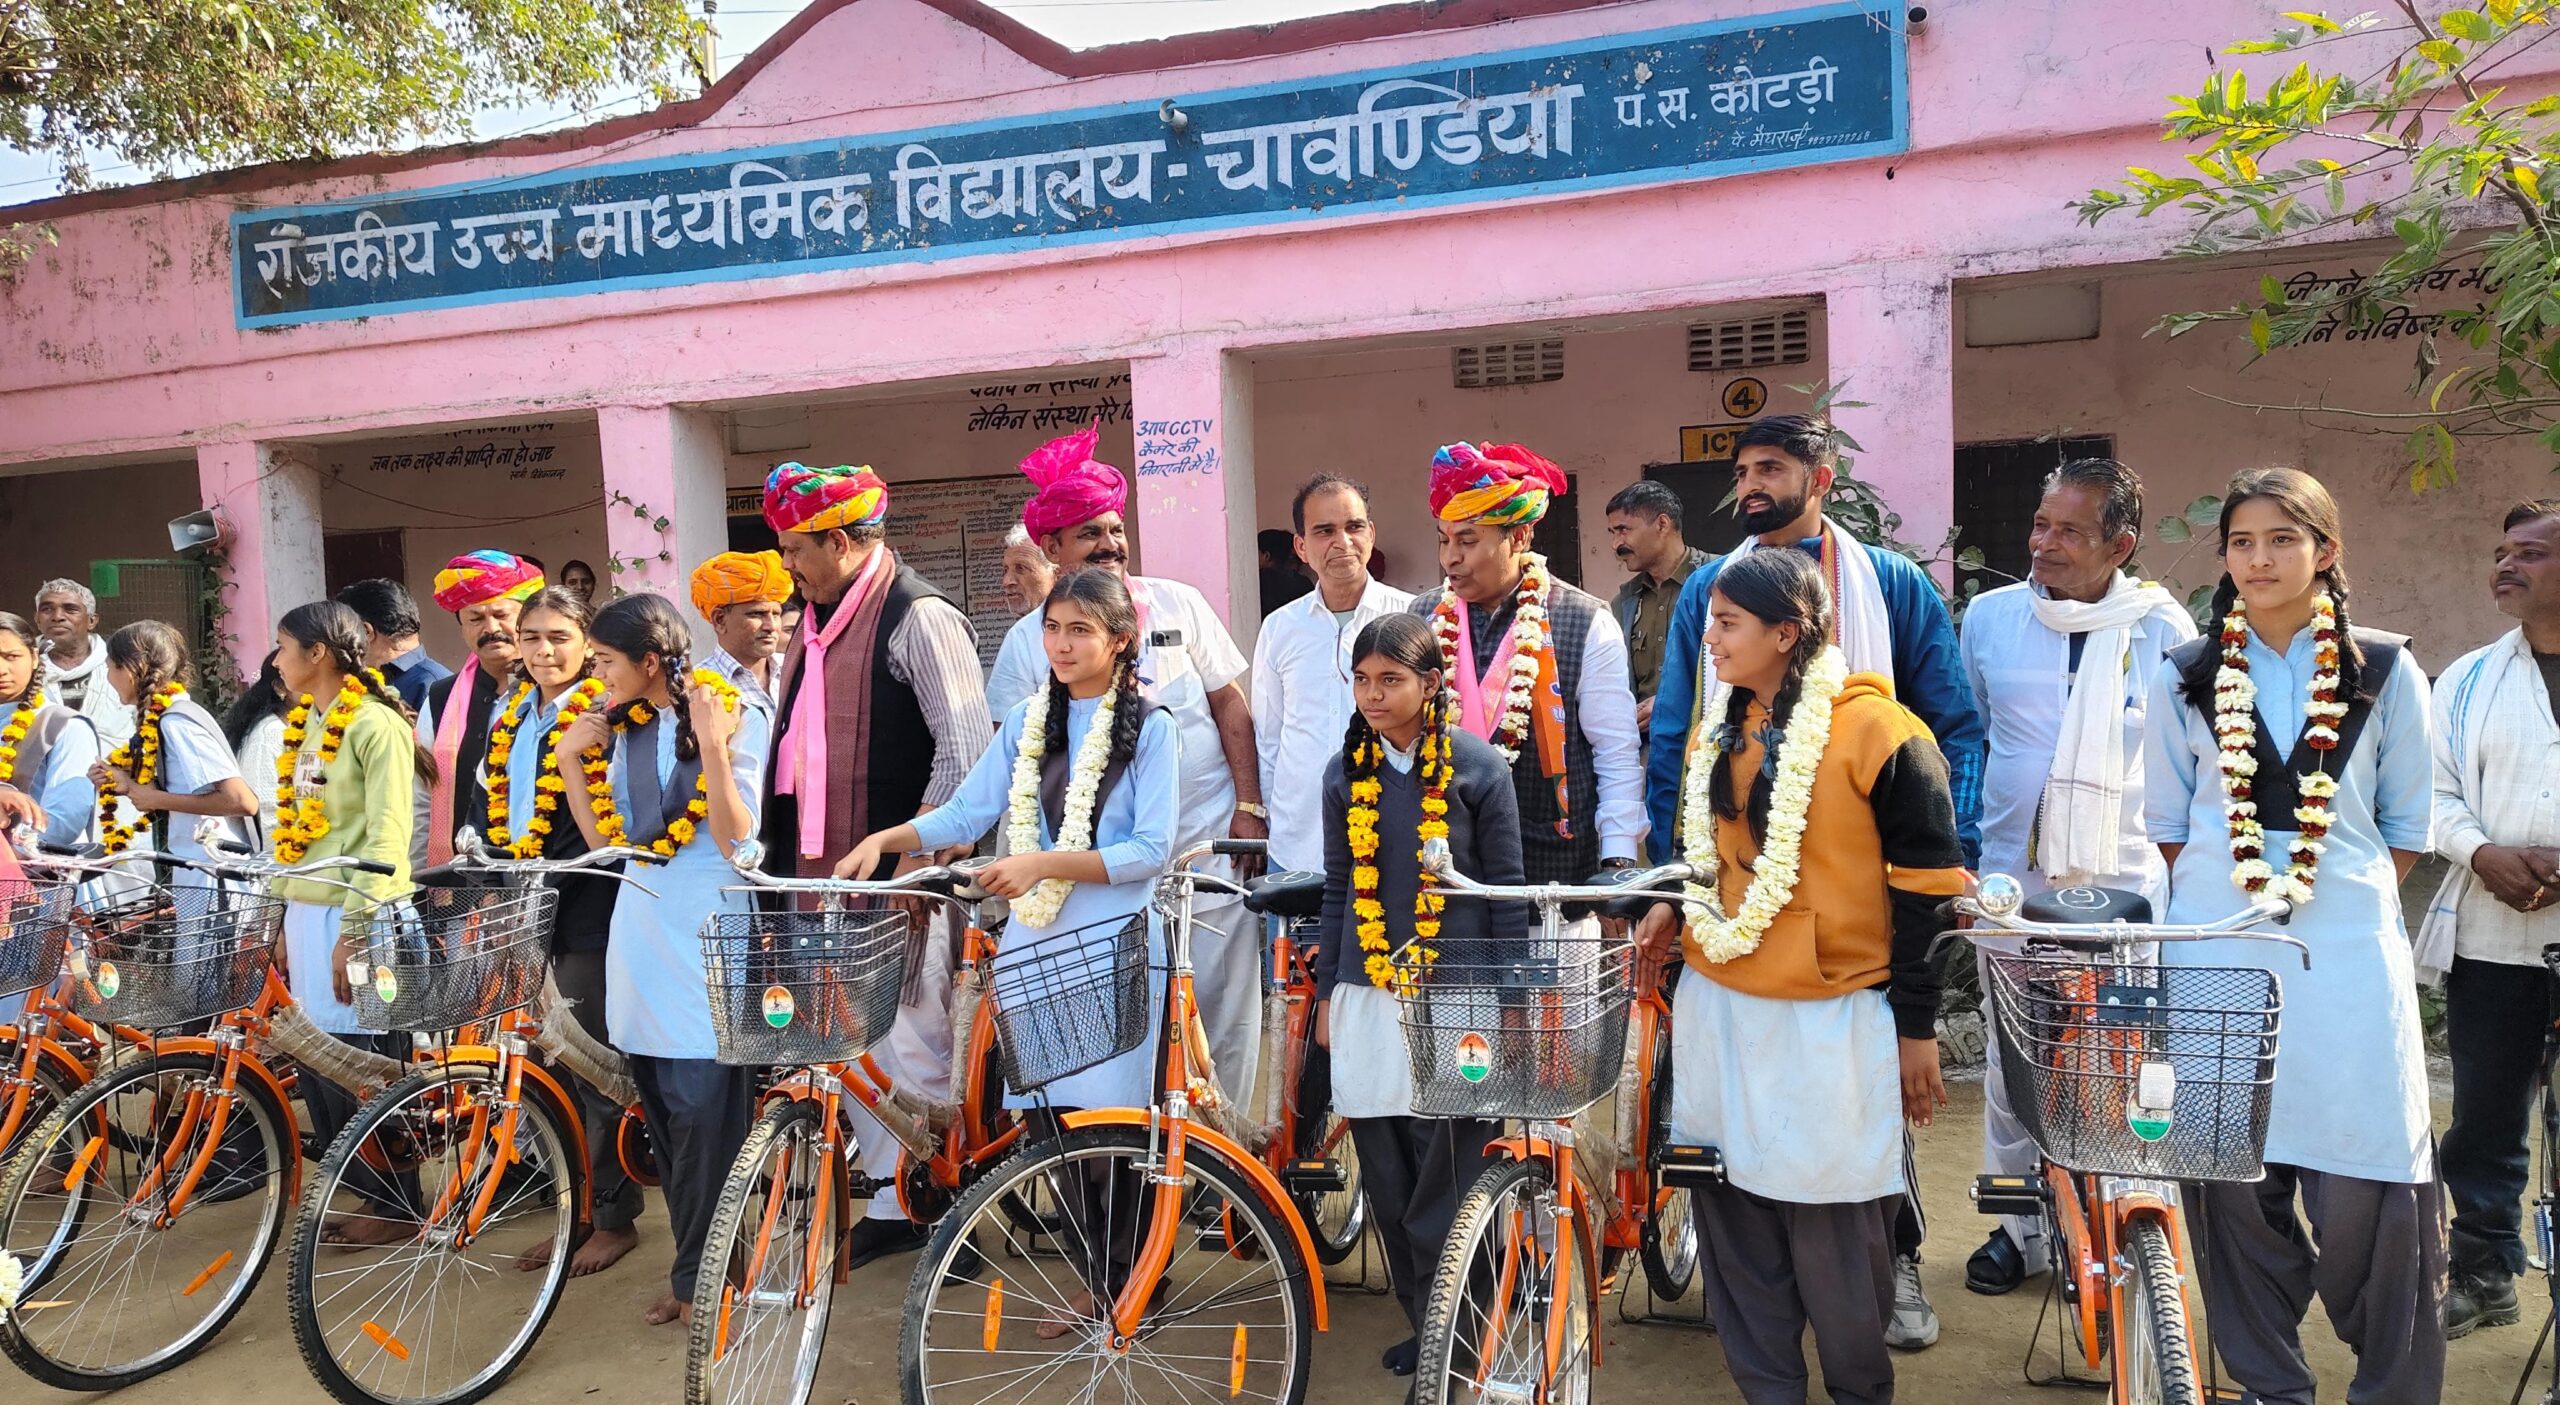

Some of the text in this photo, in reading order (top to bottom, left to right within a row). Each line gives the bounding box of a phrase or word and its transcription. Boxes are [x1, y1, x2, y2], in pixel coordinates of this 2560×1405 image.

[254, 210, 441, 299] राजकीय
[452, 208, 561, 270] उच्च
[572, 161, 872, 260] माध्यमिक
[890, 143, 1167, 230] विद्यालय
[1201, 78, 1585, 192] चावण्डिया
[1732, 386, 1755, 411] 4
[968, 403, 1031, 431] लेकिन
[1032, 402, 1091, 430] संस्था
[1136, 419, 1213, 436] आप CCTV
[369, 455, 393, 471] जब
[390, 454, 413, 472] तक
[445, 445, 464, 467] की
[496, 447, 515, 464] ना
[513, 440, 530, 467] हो
[1139, 437, 1200, 457] कैमरे की
[1137, 456, 1191, 477] निगरानी
